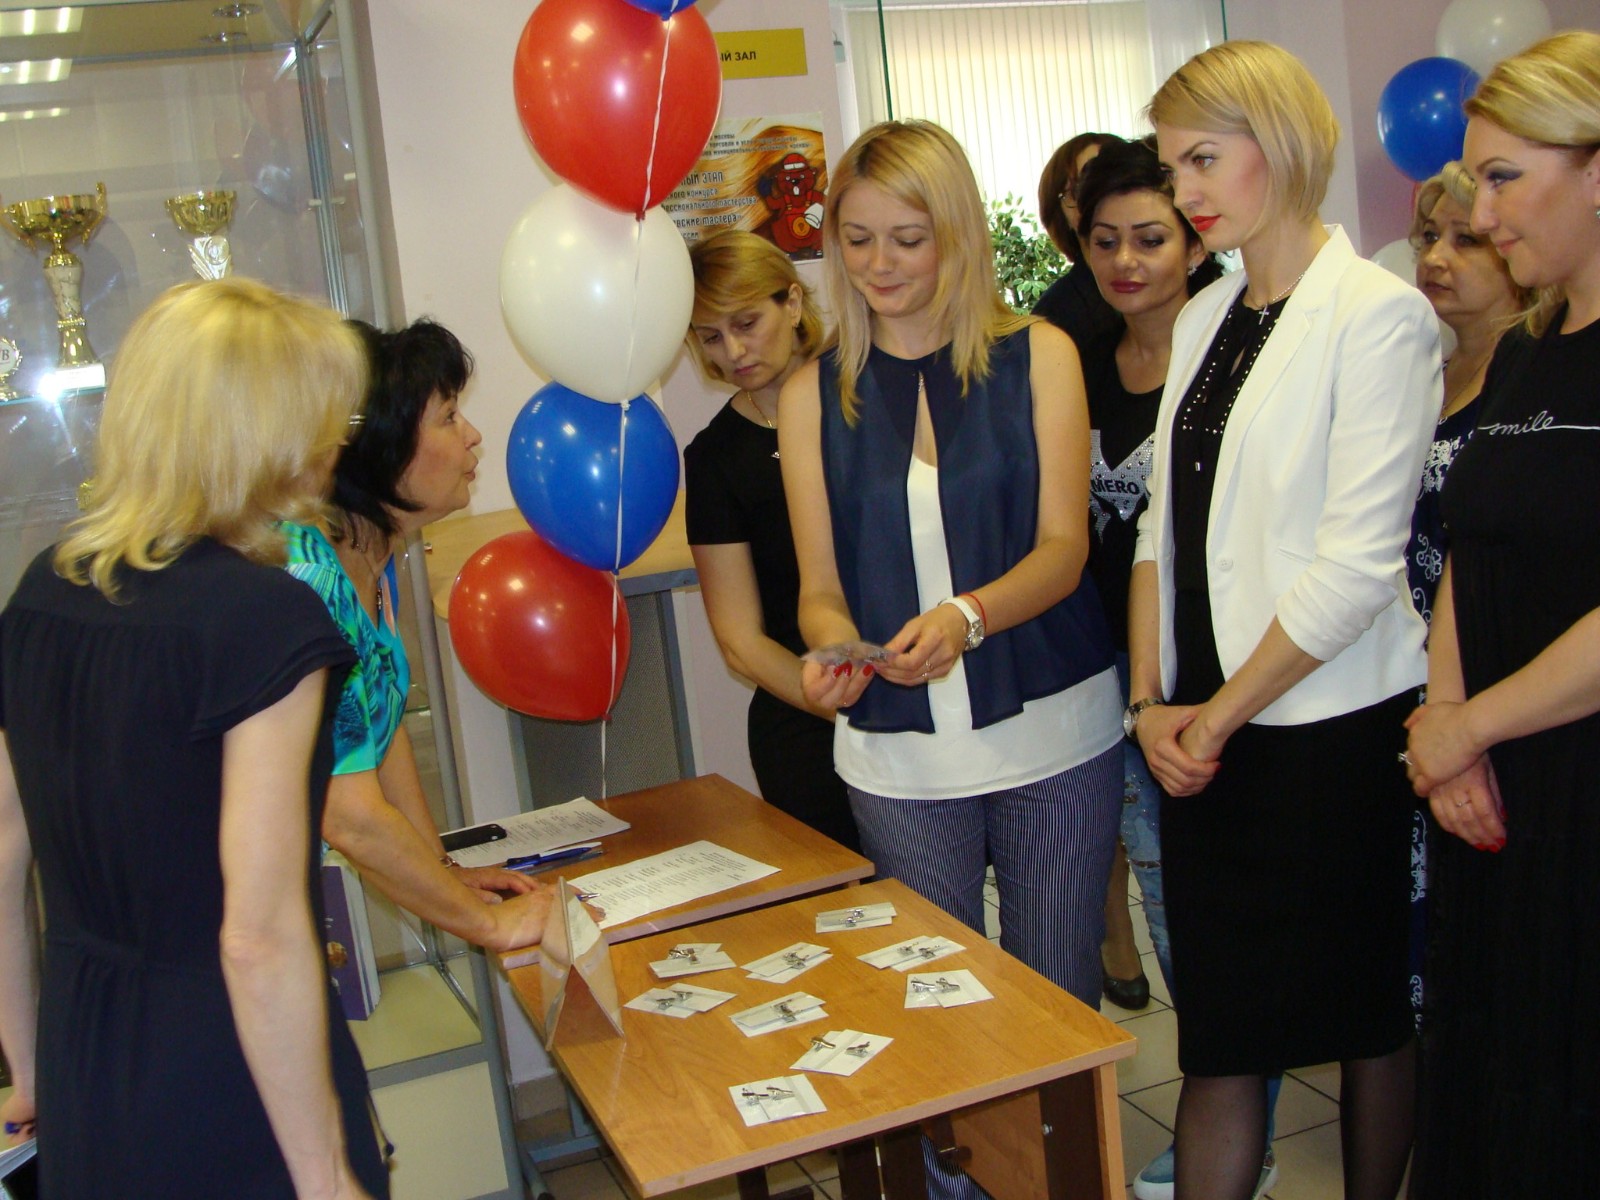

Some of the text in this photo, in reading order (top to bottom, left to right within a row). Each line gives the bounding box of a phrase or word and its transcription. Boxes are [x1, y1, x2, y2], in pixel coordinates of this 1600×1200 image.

[720, 50, 757, 62] Й ЗАЛ
[668, 191, 685, 199] кого
[1478, 410, 1554, 436] smile
